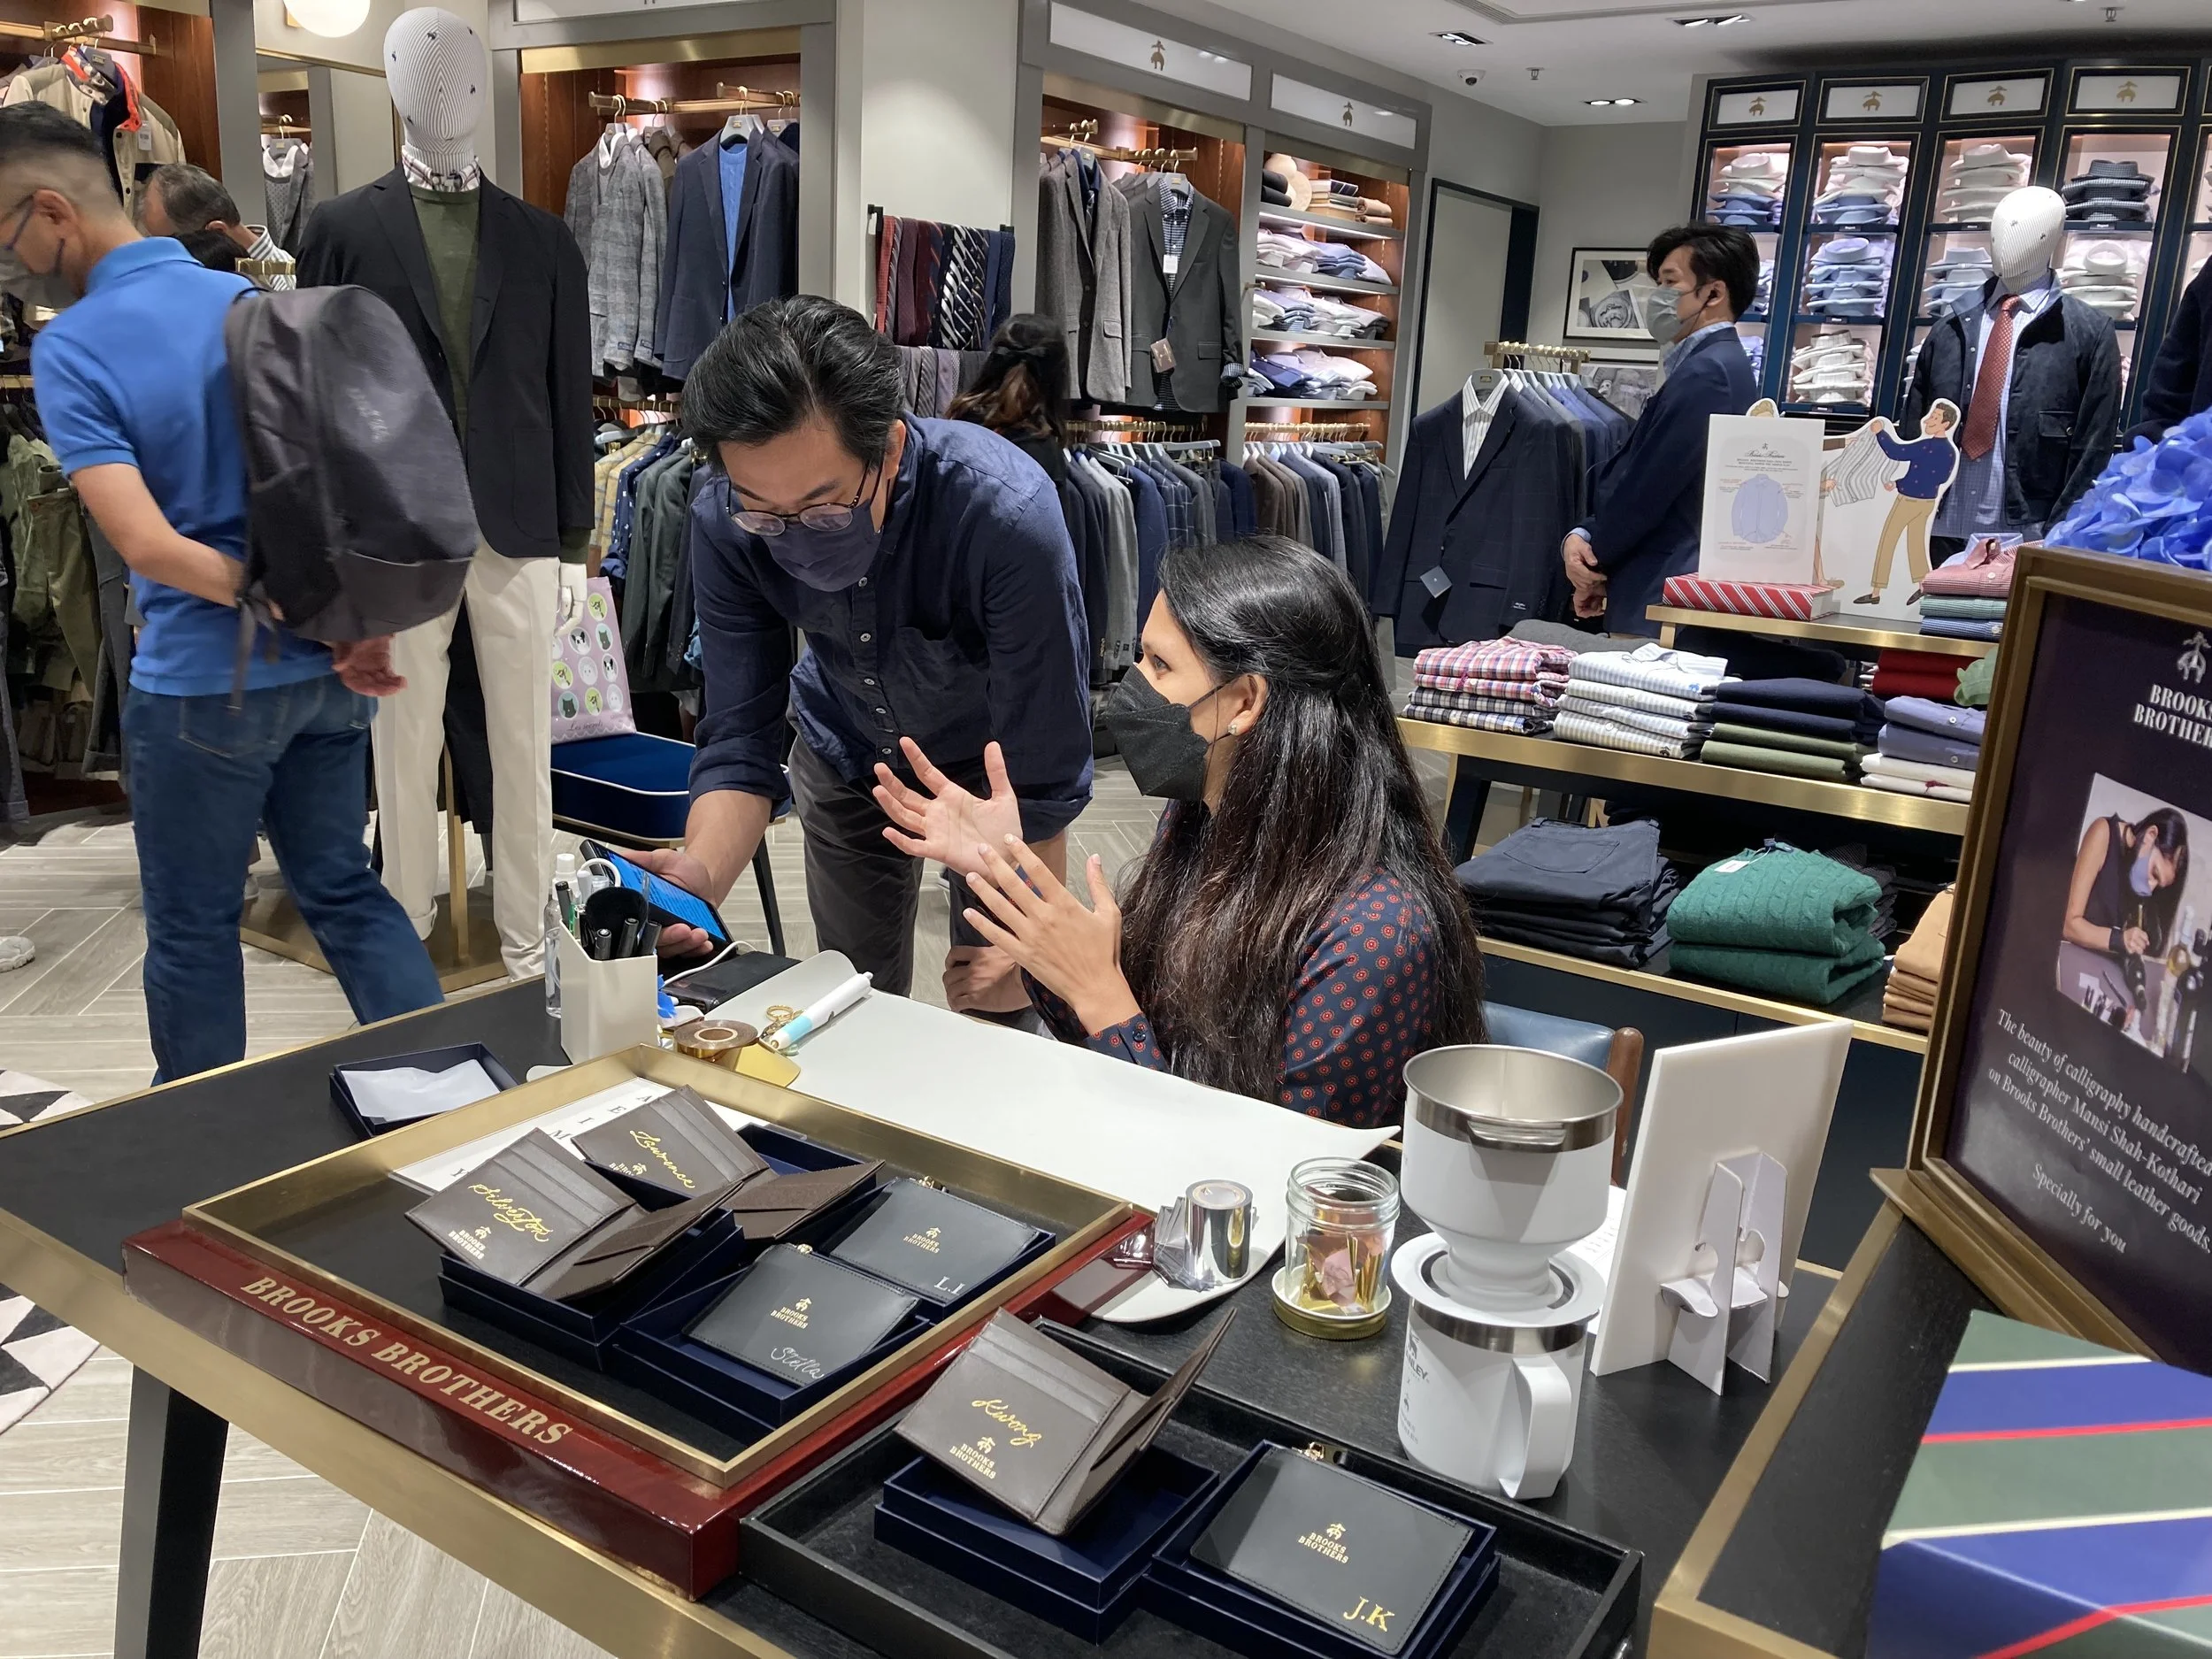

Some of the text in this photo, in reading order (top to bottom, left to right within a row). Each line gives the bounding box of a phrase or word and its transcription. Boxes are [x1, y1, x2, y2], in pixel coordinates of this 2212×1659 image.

[2133, 703, 2212, 749] BROTHER
[1998, 1009, 2017, 1034] The
[2017, 1023, 2053, 1063] beauty
[2054, 1054, 2068, 1073] of
[2065, 1063, 2131, 1120] calligraphy
[2008, 1052, 2203, 1205] calligrapher Mansi Shah-Kothari
[1988, 1067, 2001, 1086] on
[2001, 1074, 2038, 1114] Brooks
[2089, 1148, 2124, 1181] small
[2124, 1169, 2170, 1217] leather
[2168, 1212, 2210, 1254] goods.
[2032, 1164, 2127, 1254] Specially for you
[448, 1230, 485, 1260] BROTHERS
[458, 1229, 486, 1251] BROOKS
[902, 1235, 940, 1254] BROTHERS
[911, 1233, 940, 1248] BROOKS
[770, 1310, 809, 1329] BROTHERS
[780, 1306, 809, 1322] BROOKS
[241, 1277, 573, 1446] BROOKS BROTHERS
[771, 1347, 825, 1379] Stella
[972, 1399, 1042, 1448] Kwong
[949, 1446, 996, 1479] BROTHERS
[960, 1443, 995, 1469] BROOKS
[1298, 1535, 1349, 1563] BROTHERS
[1309, 1532, 1347, 1555] BROOKS
[1343, 1595, 1395, 1632] J.K
